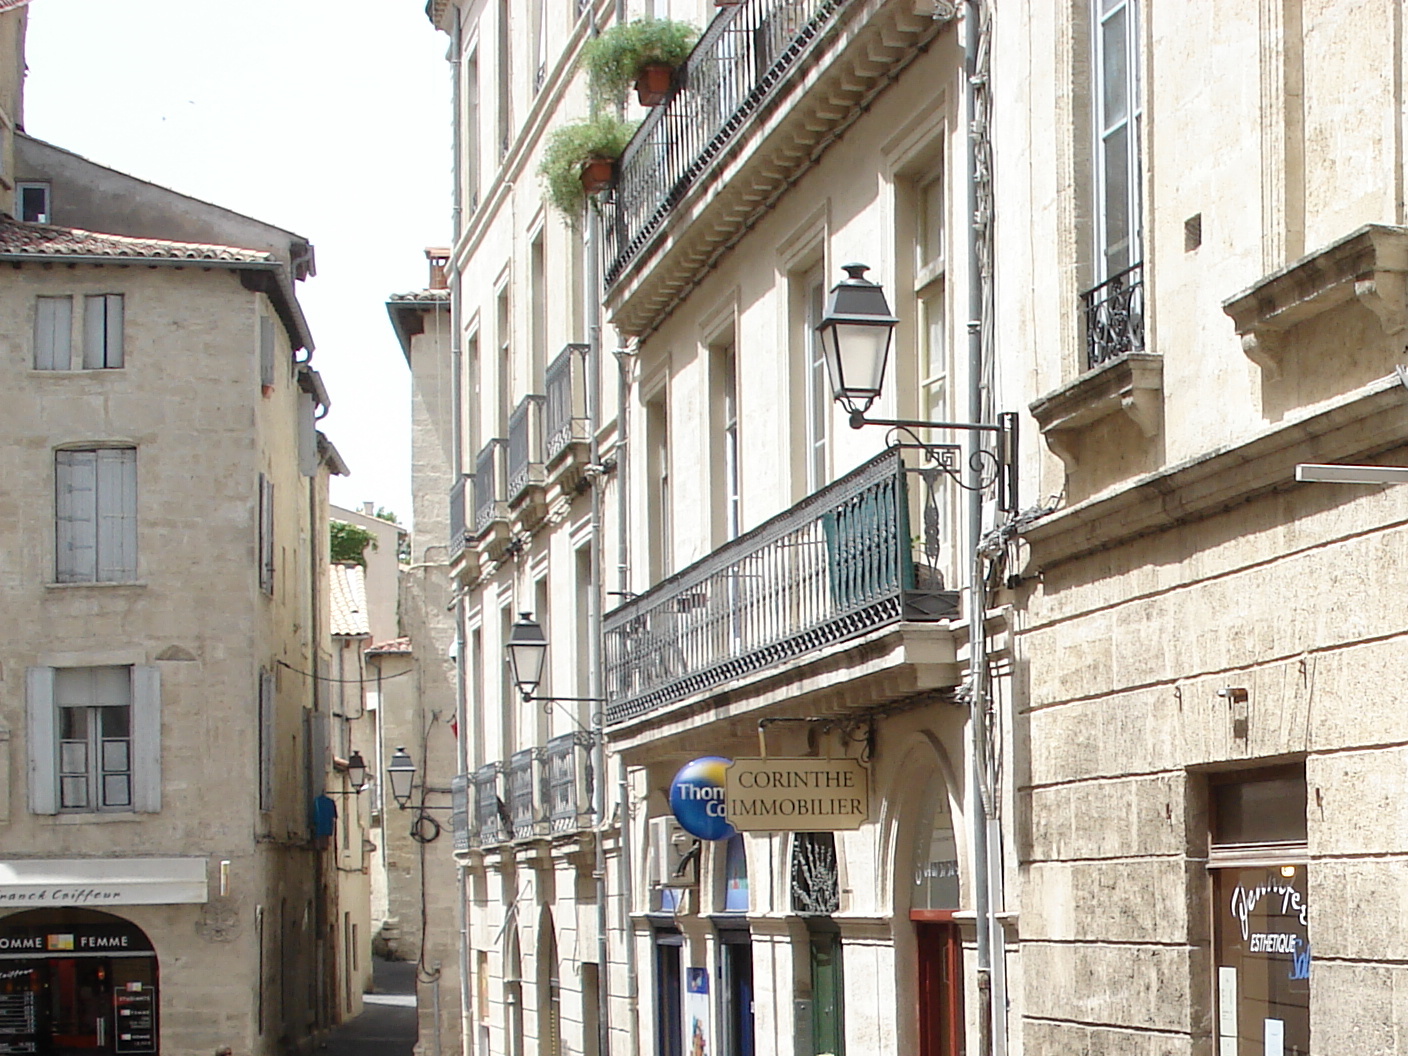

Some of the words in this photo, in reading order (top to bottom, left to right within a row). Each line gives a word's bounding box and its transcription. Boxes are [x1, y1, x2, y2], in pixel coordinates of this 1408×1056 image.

[738, 770, 855, 789] CORINTHE
[676, 783, 726, 801] Thom
[705, 800, 727, 818] Co
[731, 797, 864, 816] IMMOBILIER
[0, 889, 47, 901] ranck
[51, 889, 121, 903] Coiffeur
[0, 938, 42, 949] OMME
[80, 936, 128, 947] FEMME
[1250, 933, 1297, 953] ESTHETIQUE
